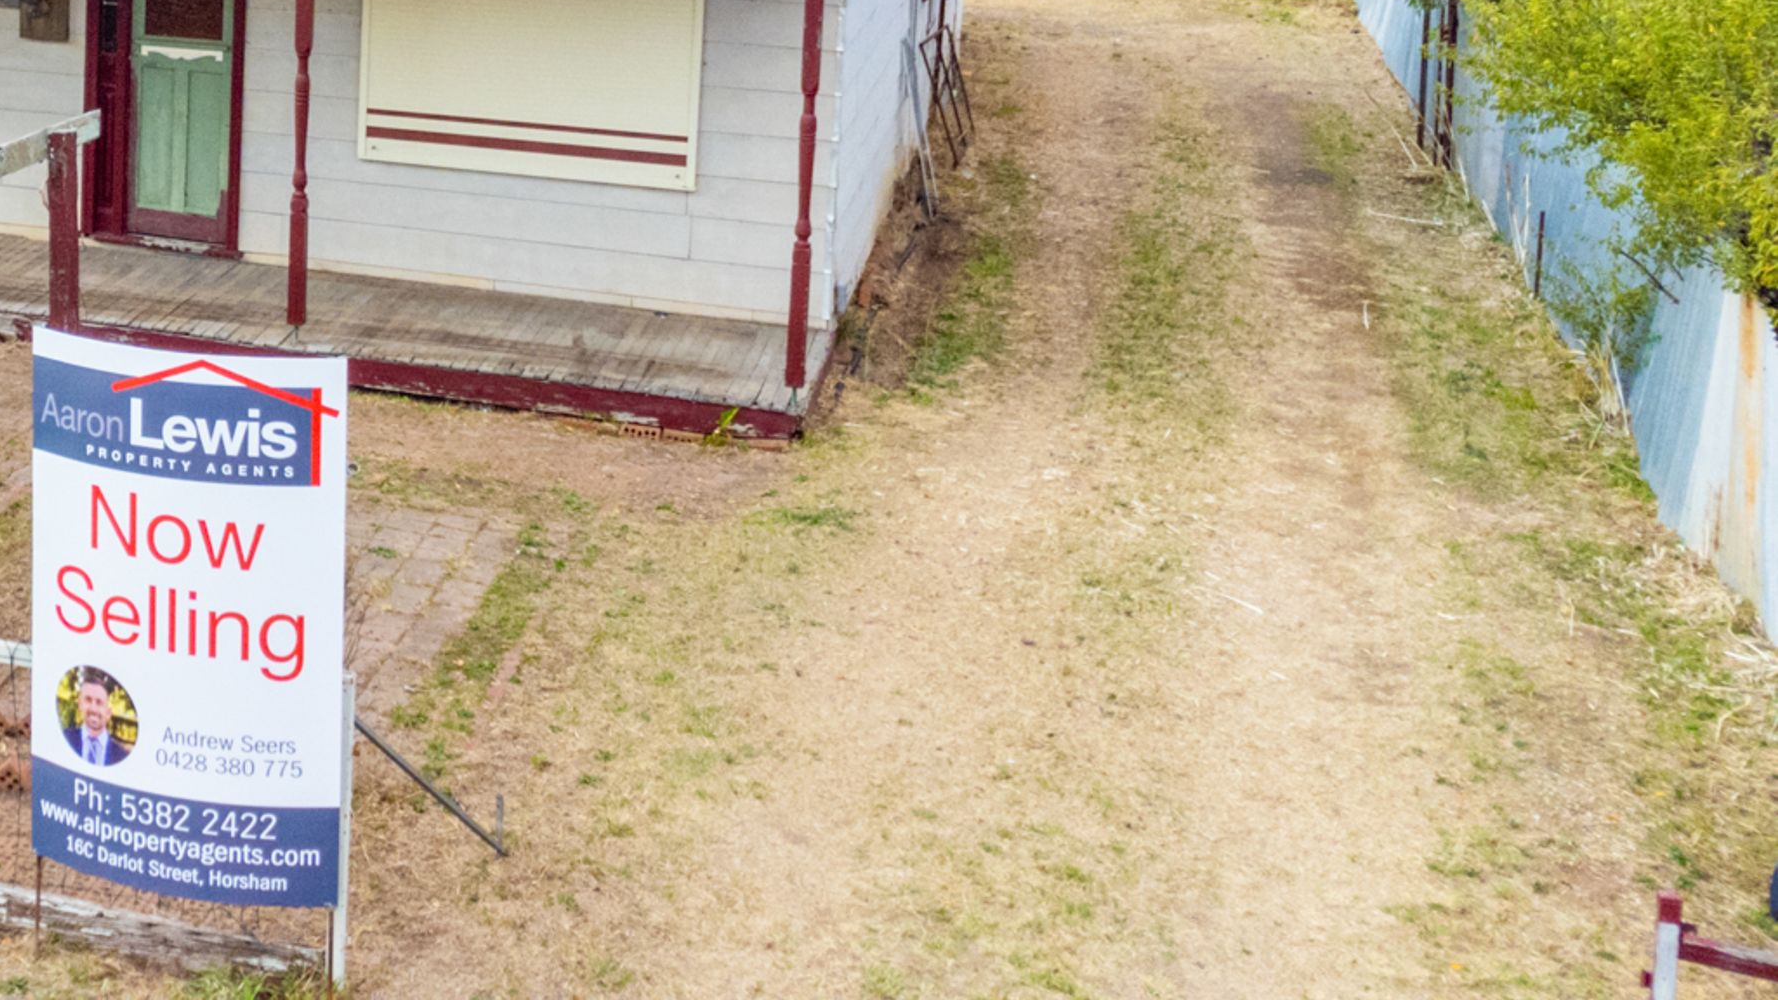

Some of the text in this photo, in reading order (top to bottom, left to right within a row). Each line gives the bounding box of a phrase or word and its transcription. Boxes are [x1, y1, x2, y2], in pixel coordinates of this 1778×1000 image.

[41, 393, 297, 460] Aaron Lewis
[86, 444, 295, 478] PROPERTY AGENTS
[91, 484, 265, 571] Now
[55, 565, 305, 682] Selling
[155, 748, 304, 779] 0428 380 775
[162, 726, 297, 755] Andrew Seers
[40, 798, 321, 866] www.alpropertyagents.com
[74, 778, 278, 840] Ph: 5382 2422
[66, 834, 288, 892] 16C Darlot Street, Horsham
